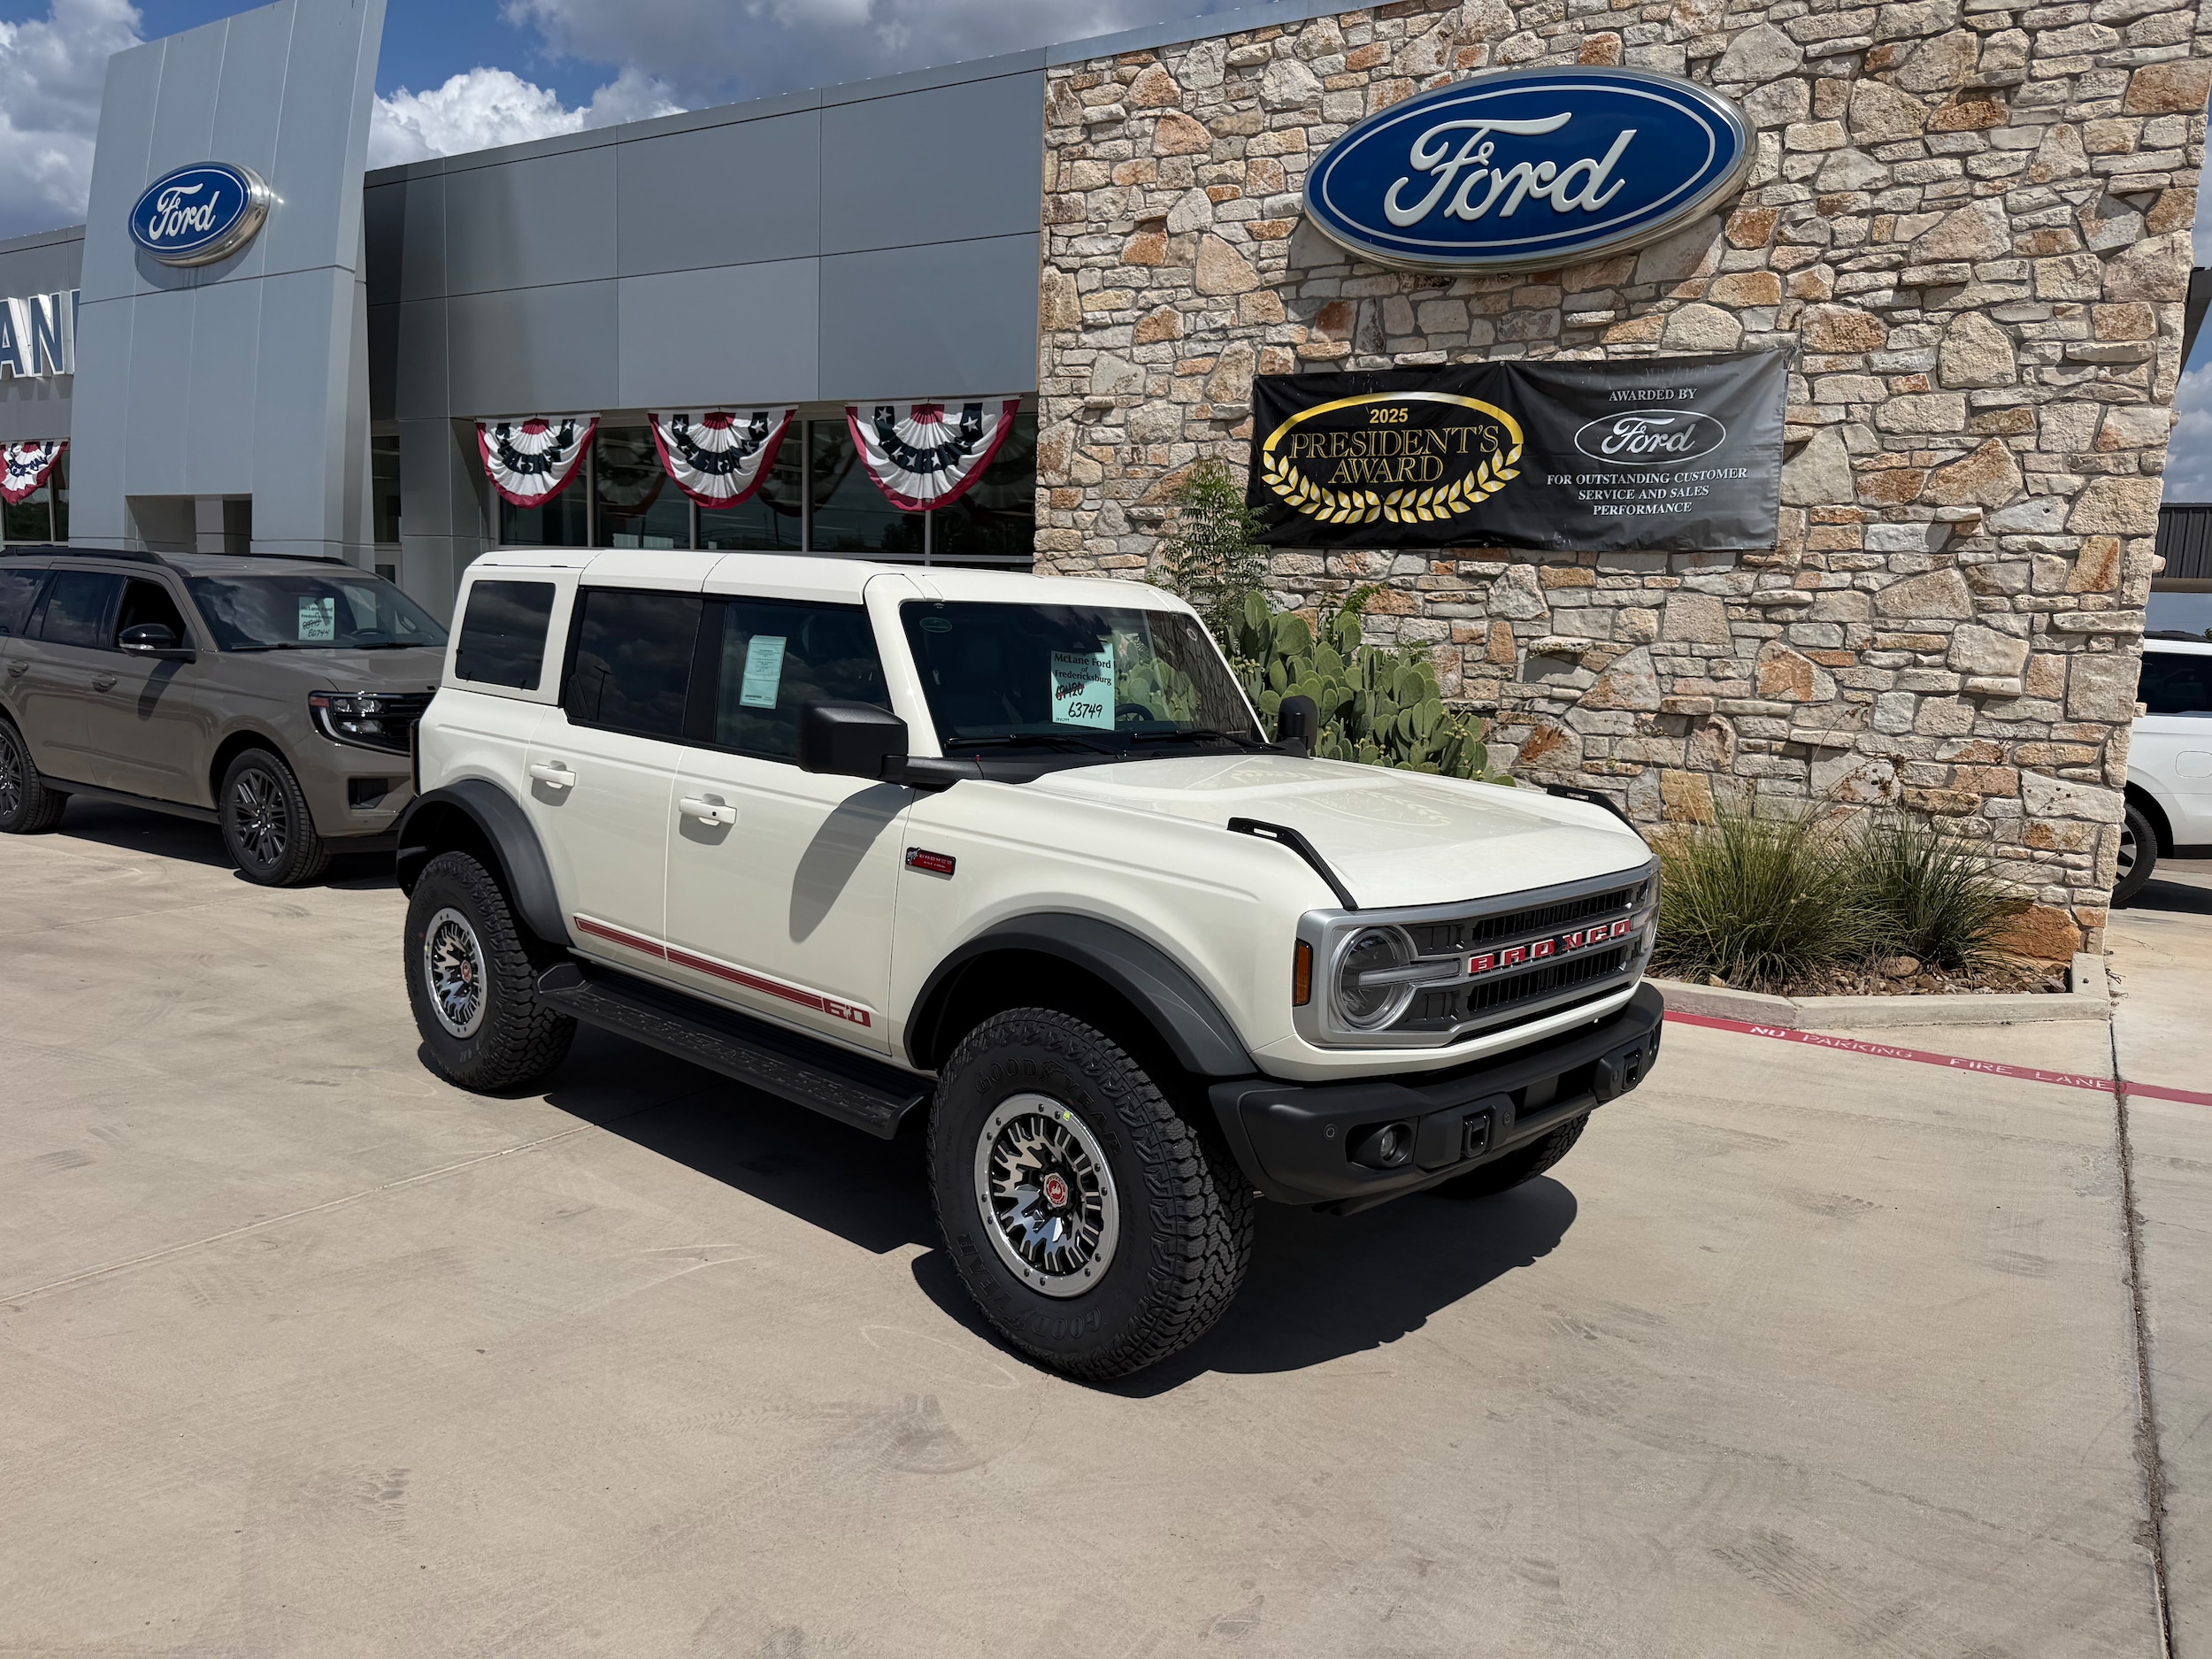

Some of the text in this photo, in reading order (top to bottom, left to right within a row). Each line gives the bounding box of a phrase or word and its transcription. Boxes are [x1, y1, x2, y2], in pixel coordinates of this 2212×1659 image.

[1383, 111, 1638, 227] Ford
[149, 182, 220, 241] Ford
[1609, 388, 1697, 402] AWARDED BY
[1369, 408, 1409, 424] 2025
[1288, 425, 1499, 459] PRESIDENT'S
[1601, 417, 1697, 454] Ford
[1327, 456, 1444, 484] AWARD
[1548, 467, 1748, 486] FOR OUTSTANDING CUSTOMER
[1578, 485, 1709, 501] SERVICE AND SALES
[1593, 502, 1693, 516] PERFORMANCE
[1054, 653, 1111, 669] McLane Ford
[1055, 669, 1112, 687] Fredericksburg
[1068, 702, 1102, 719] 63749
[1468, 918, 1631, 973] BRONCO
[1750, 1025, 2115, 1091] NO PARKING FIRE LANE
[974, 1056, 1124, 1157] GOODYEAR
